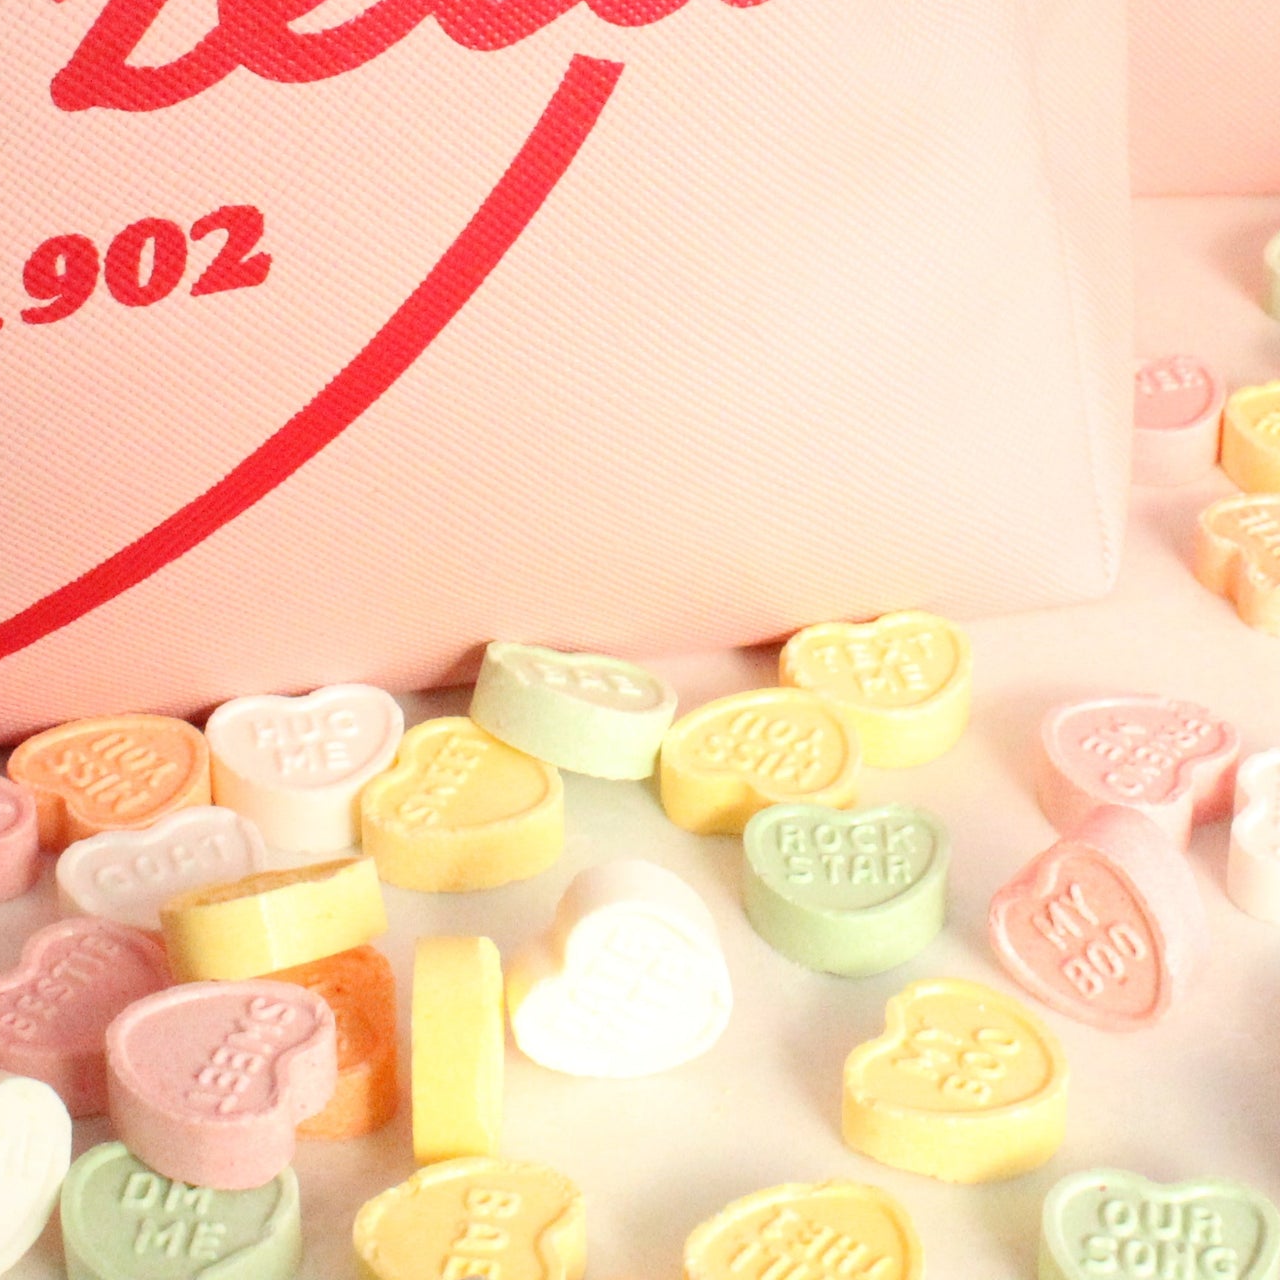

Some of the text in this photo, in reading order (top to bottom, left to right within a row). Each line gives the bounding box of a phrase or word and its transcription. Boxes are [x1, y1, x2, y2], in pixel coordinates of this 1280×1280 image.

[814, 631, 934, 674] TEXT
[854, 662, 927, 696] ME
[254, 709, 360, 748] HUG
[728, 710, 824, 748] YOU
[1081, 718, 1148, 762] ME
[51, 750, 152, 814] MISS
[90, 734, 178, 787] YOU
[280, 740, 350, 776] ME
[395, 731, 490, 827] SWEET
[698, 731, 821, 782] MISS
[1104, 717, 1213, 796] FRIEND
[95, 831, 230, 893] GOAT
[777, 822, 917, 855] ROCK
[783, 854, 914, 886] STAR
[1030, 881, 1100, 953] MY
[1, 933, 121, 1043] BESTIE
[1064, 930, 1147, 997] BOO
[186, 998, 297, 1114] SWEET
[892, 1018, 953, 1080] MY
[940, 1026, 1020, 1104] BOO
[120, 1171, 214, 1216] DM
[134, 1219, 227, 1259] ME
[442, 1187, 522, 1280] BAE
[1100, 1200, 1222, 1242] OUR
[1079, 1234, 1238, 1280] SONG
